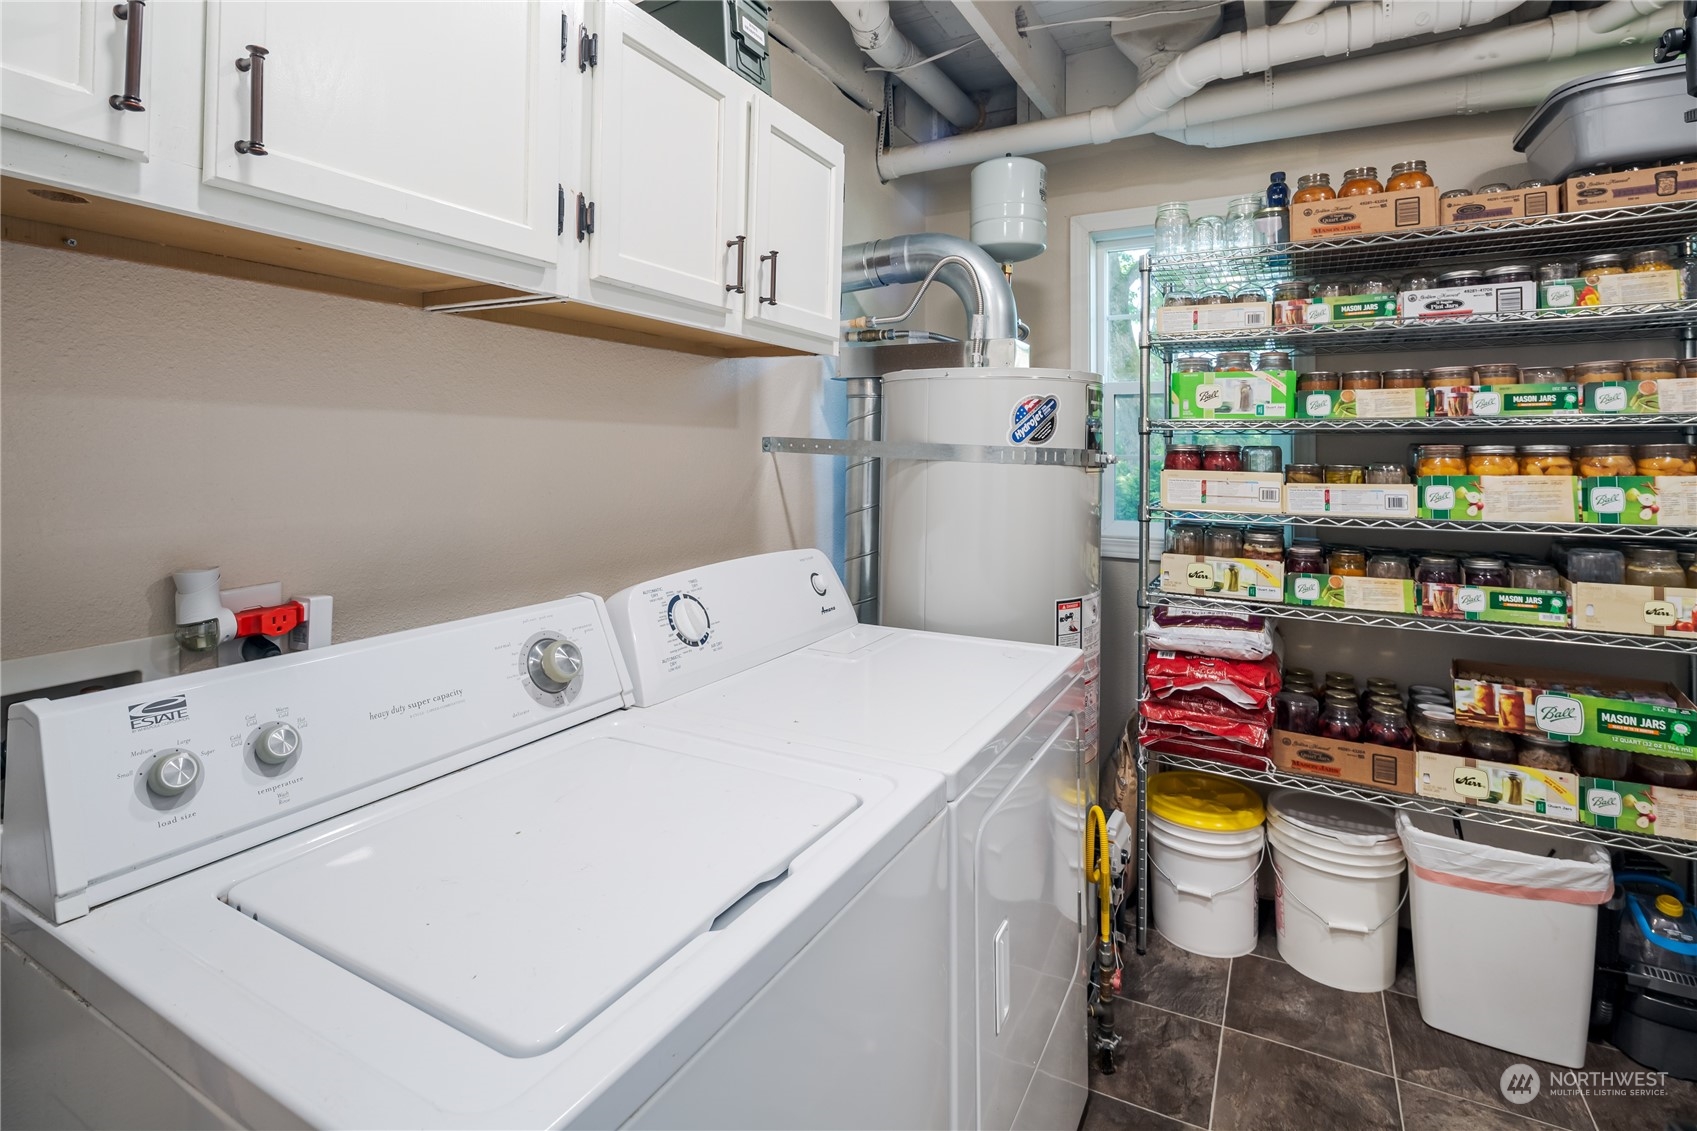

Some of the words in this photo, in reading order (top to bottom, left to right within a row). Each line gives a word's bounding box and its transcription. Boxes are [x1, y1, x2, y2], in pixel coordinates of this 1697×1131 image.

[1309, 308, 1327, 320] Ball
[1341, 304, 1362, 313] MASON
[1363, 303, 1379, 311] JARS
[1199, 389, 1220, 403] Ball
[1513, 395, 1538, 403] MASON
[1539, 394, 1557, 402] JARS
[1598, 392, 1622, 405] Ball
[1309, 399, 1328, 411] Ball
[1475, 397, 1496, 410] Ball
[1428, 491, 1451, 504] Ball
[1595, 493, 1620, 507] Ball
[1188, 570, 1209, 580] Kerr
[1297, 583, 1316, 594] Ball
[1461, 594, 1482, 606] Ball
[1498, 594, 1523, 603] MASON
[1525, 596, 1543, 605] JARS
[821, 606, 836, 615] Amana
[369, 710, 389, 720] heavy
[391, 705, 406, 715] duty
[408, 697, 431, 709] super
[432, 688, 463, 702] capacity
[130, 709, 189, 729] ESTATE
[1541, 706, 1576, 723] Ball
[1601, 712, 1637, 727] MASON
[1640, 718, 1667, 730] JARS
[1620, 737, 1641, 745] QUART
[131, 747, 153, 758] Medium
[257, 776, 304, 795] temperature
[1455, 776, 1482, 788] Kerr
[1592, 796, 1617, 808] Ball
[157, 817, 178, 828] load
[180, 812, 197, 821] size
